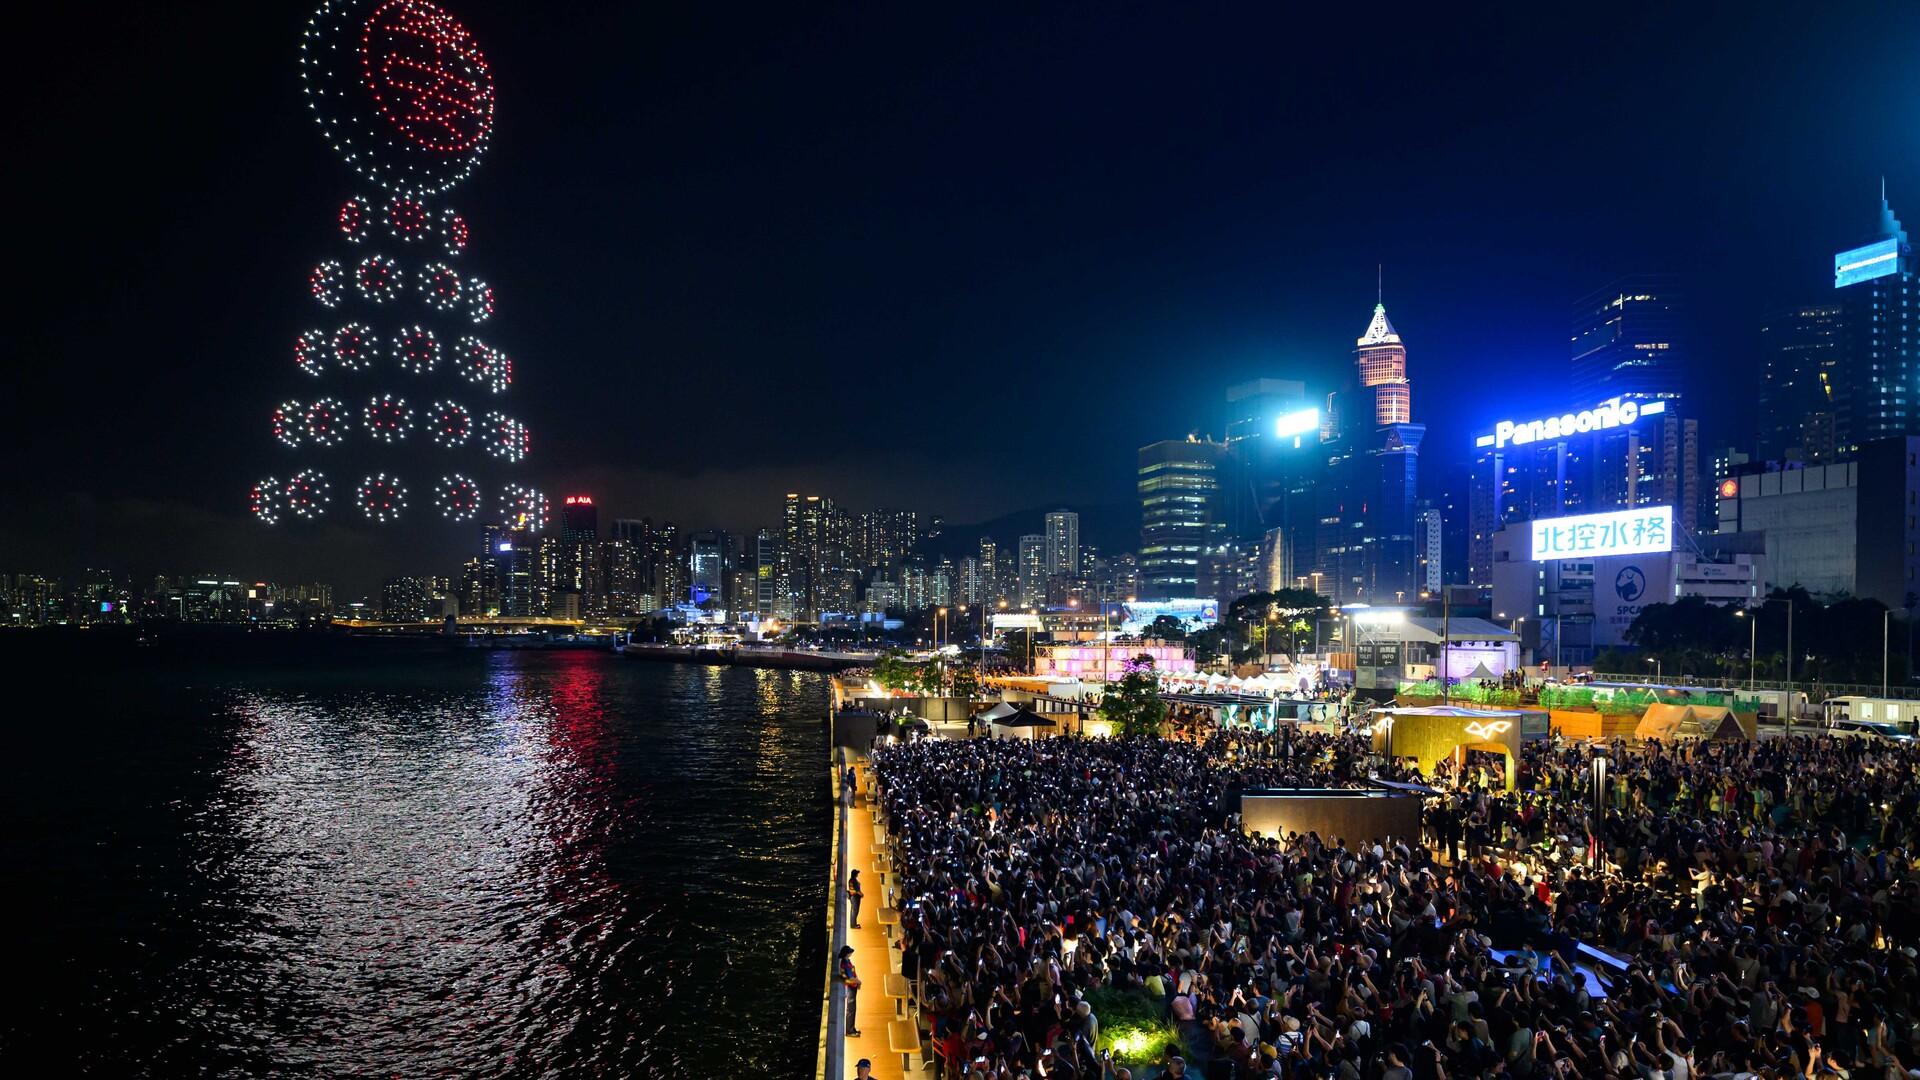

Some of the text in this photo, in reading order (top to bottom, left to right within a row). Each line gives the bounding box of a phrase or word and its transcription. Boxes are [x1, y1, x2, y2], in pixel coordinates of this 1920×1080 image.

[1496, 397, 1637, 448] Panasonic
[577, 496, 592, 504] AIA
[1537, 516, 1665, 553] 北控水務
